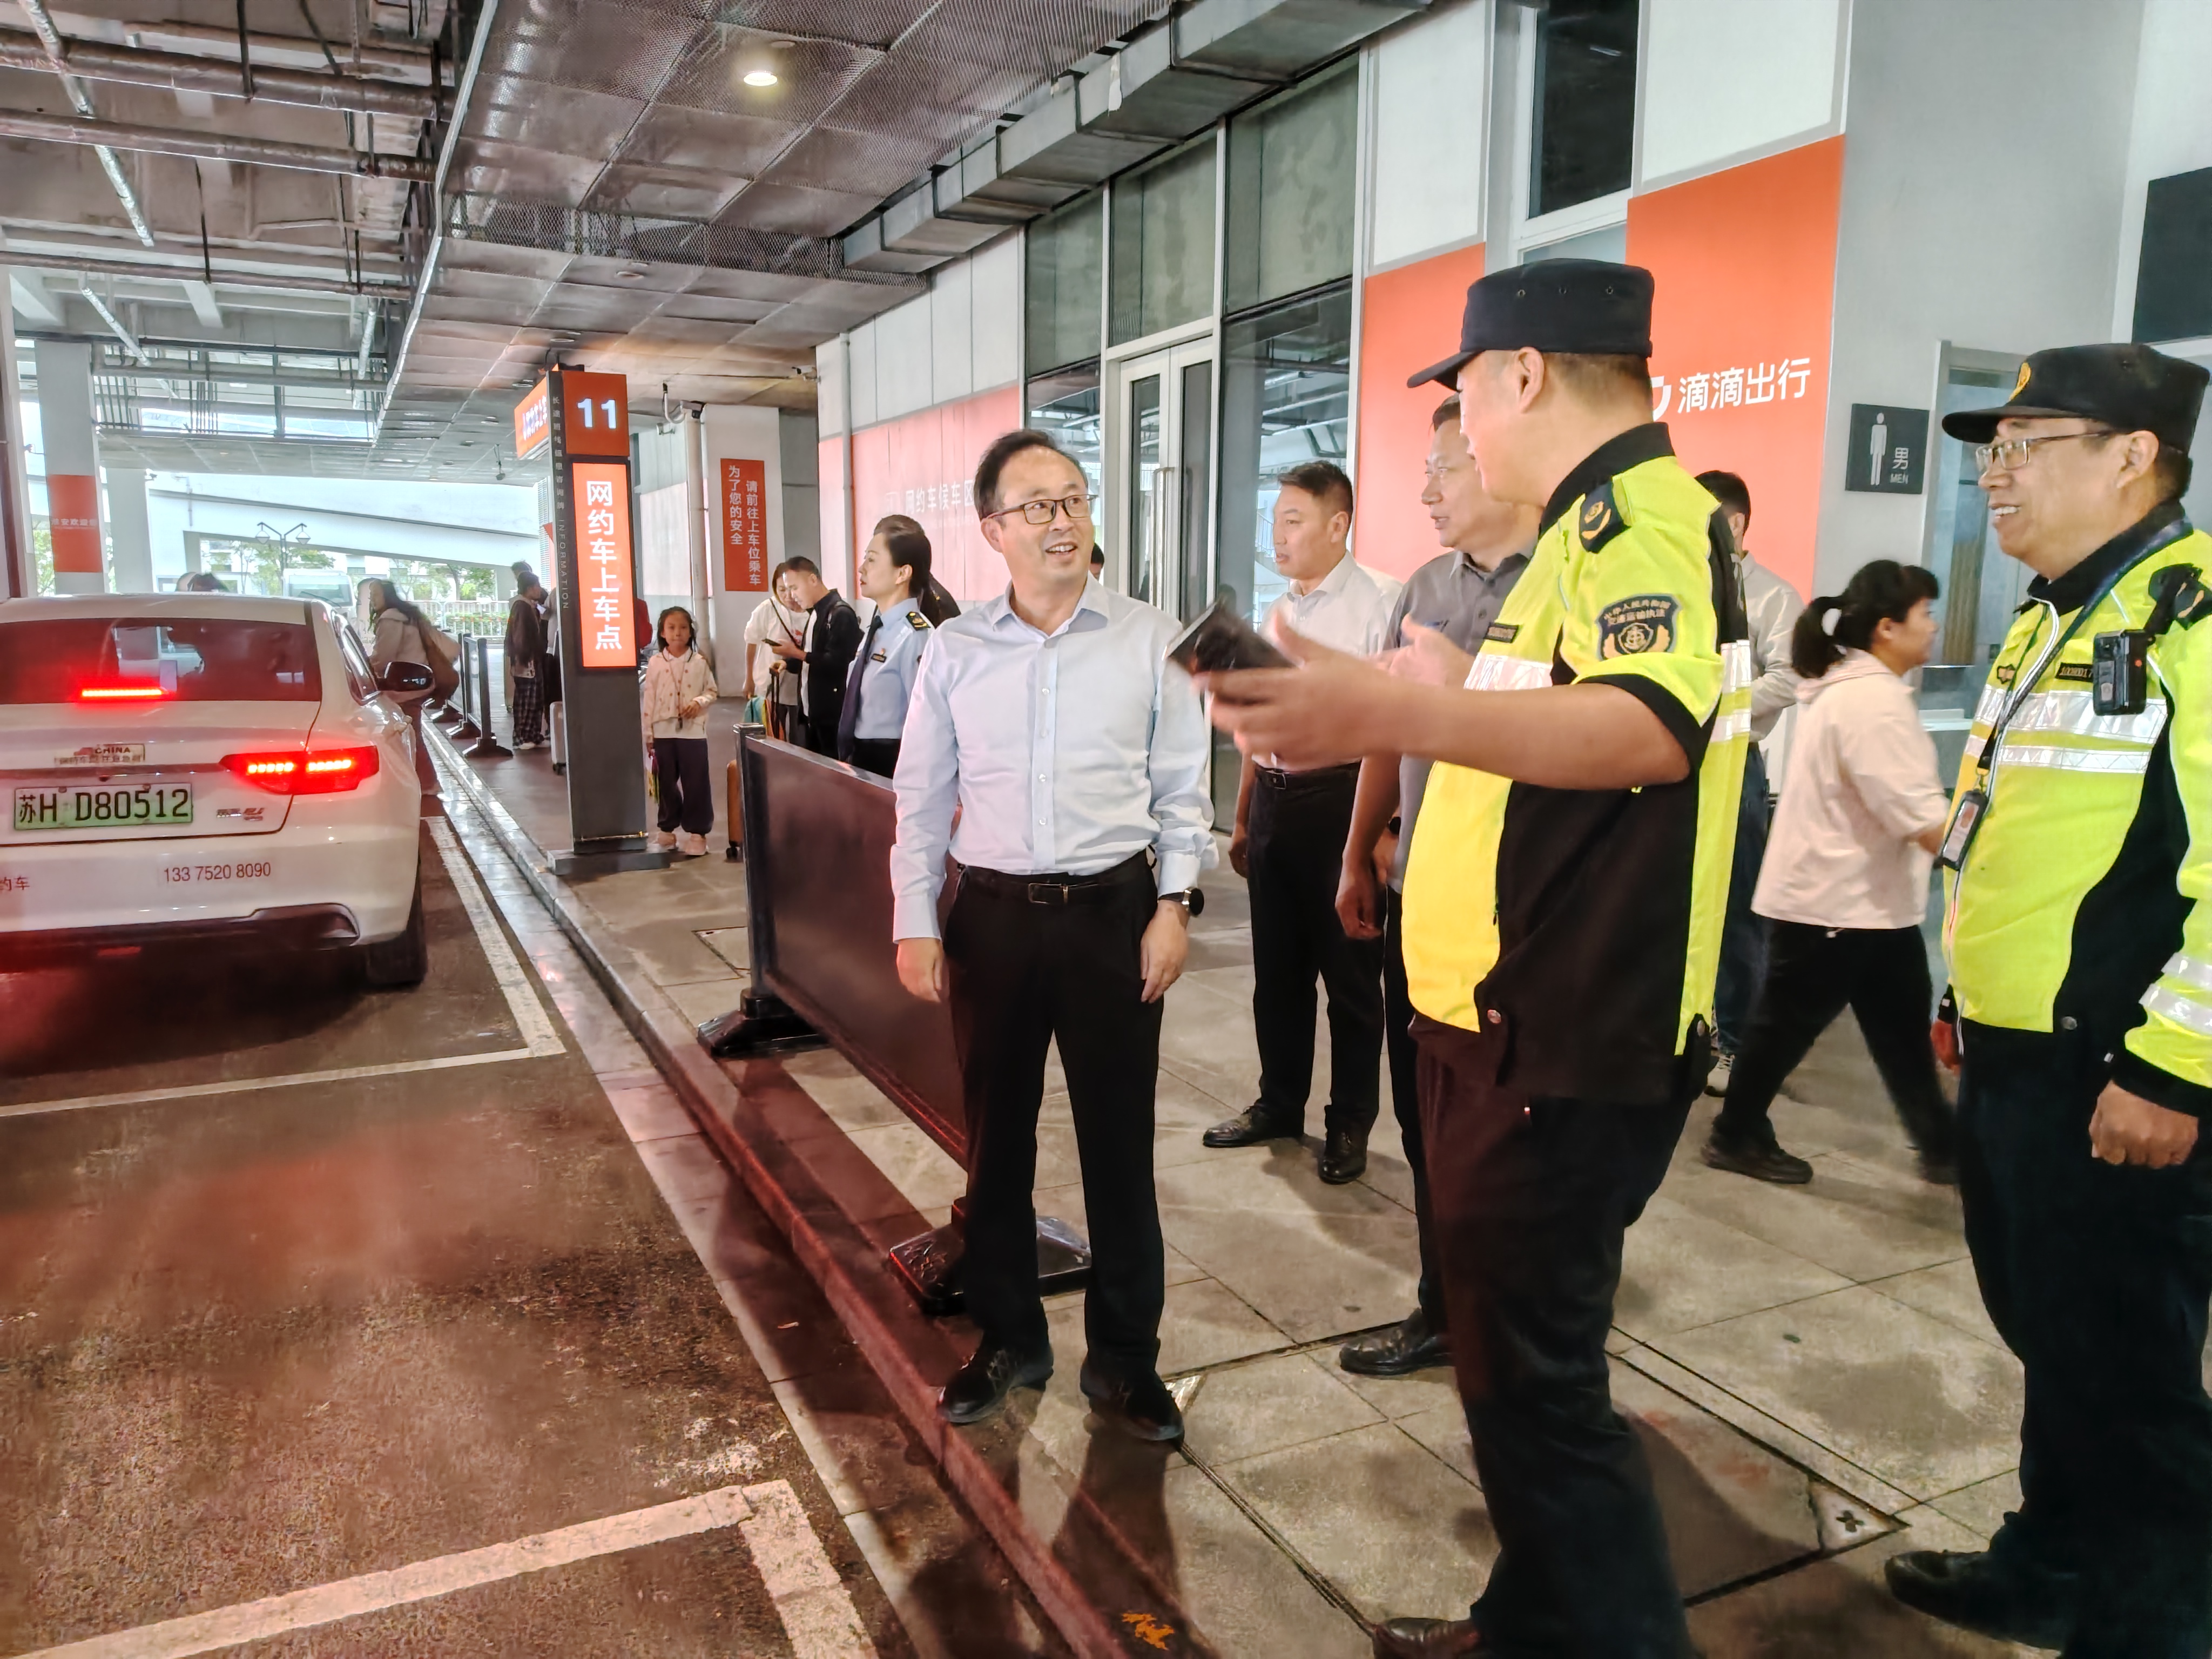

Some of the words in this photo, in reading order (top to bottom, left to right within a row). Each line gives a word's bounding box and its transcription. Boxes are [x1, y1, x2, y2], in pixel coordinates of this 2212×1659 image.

[577, 398, 616, 429] 11
[1677, 357, 1811, 414] 滴滴出行
[1890, 473, 1908, 484] MEN
[1892, 447, 1909, 470] 男
[729, 465, 743, 545] 为了您的安全
[746, 480, 761, 585] 请前往上车位乘车
[558, 519, 569, 609] INFORMATION
[586, 481, 622, 650] 网约车上车点
[164, 867, 190, 883] 133
[195, 865, 231, 881] 7520
[236, 862, 271, 878] 8090
